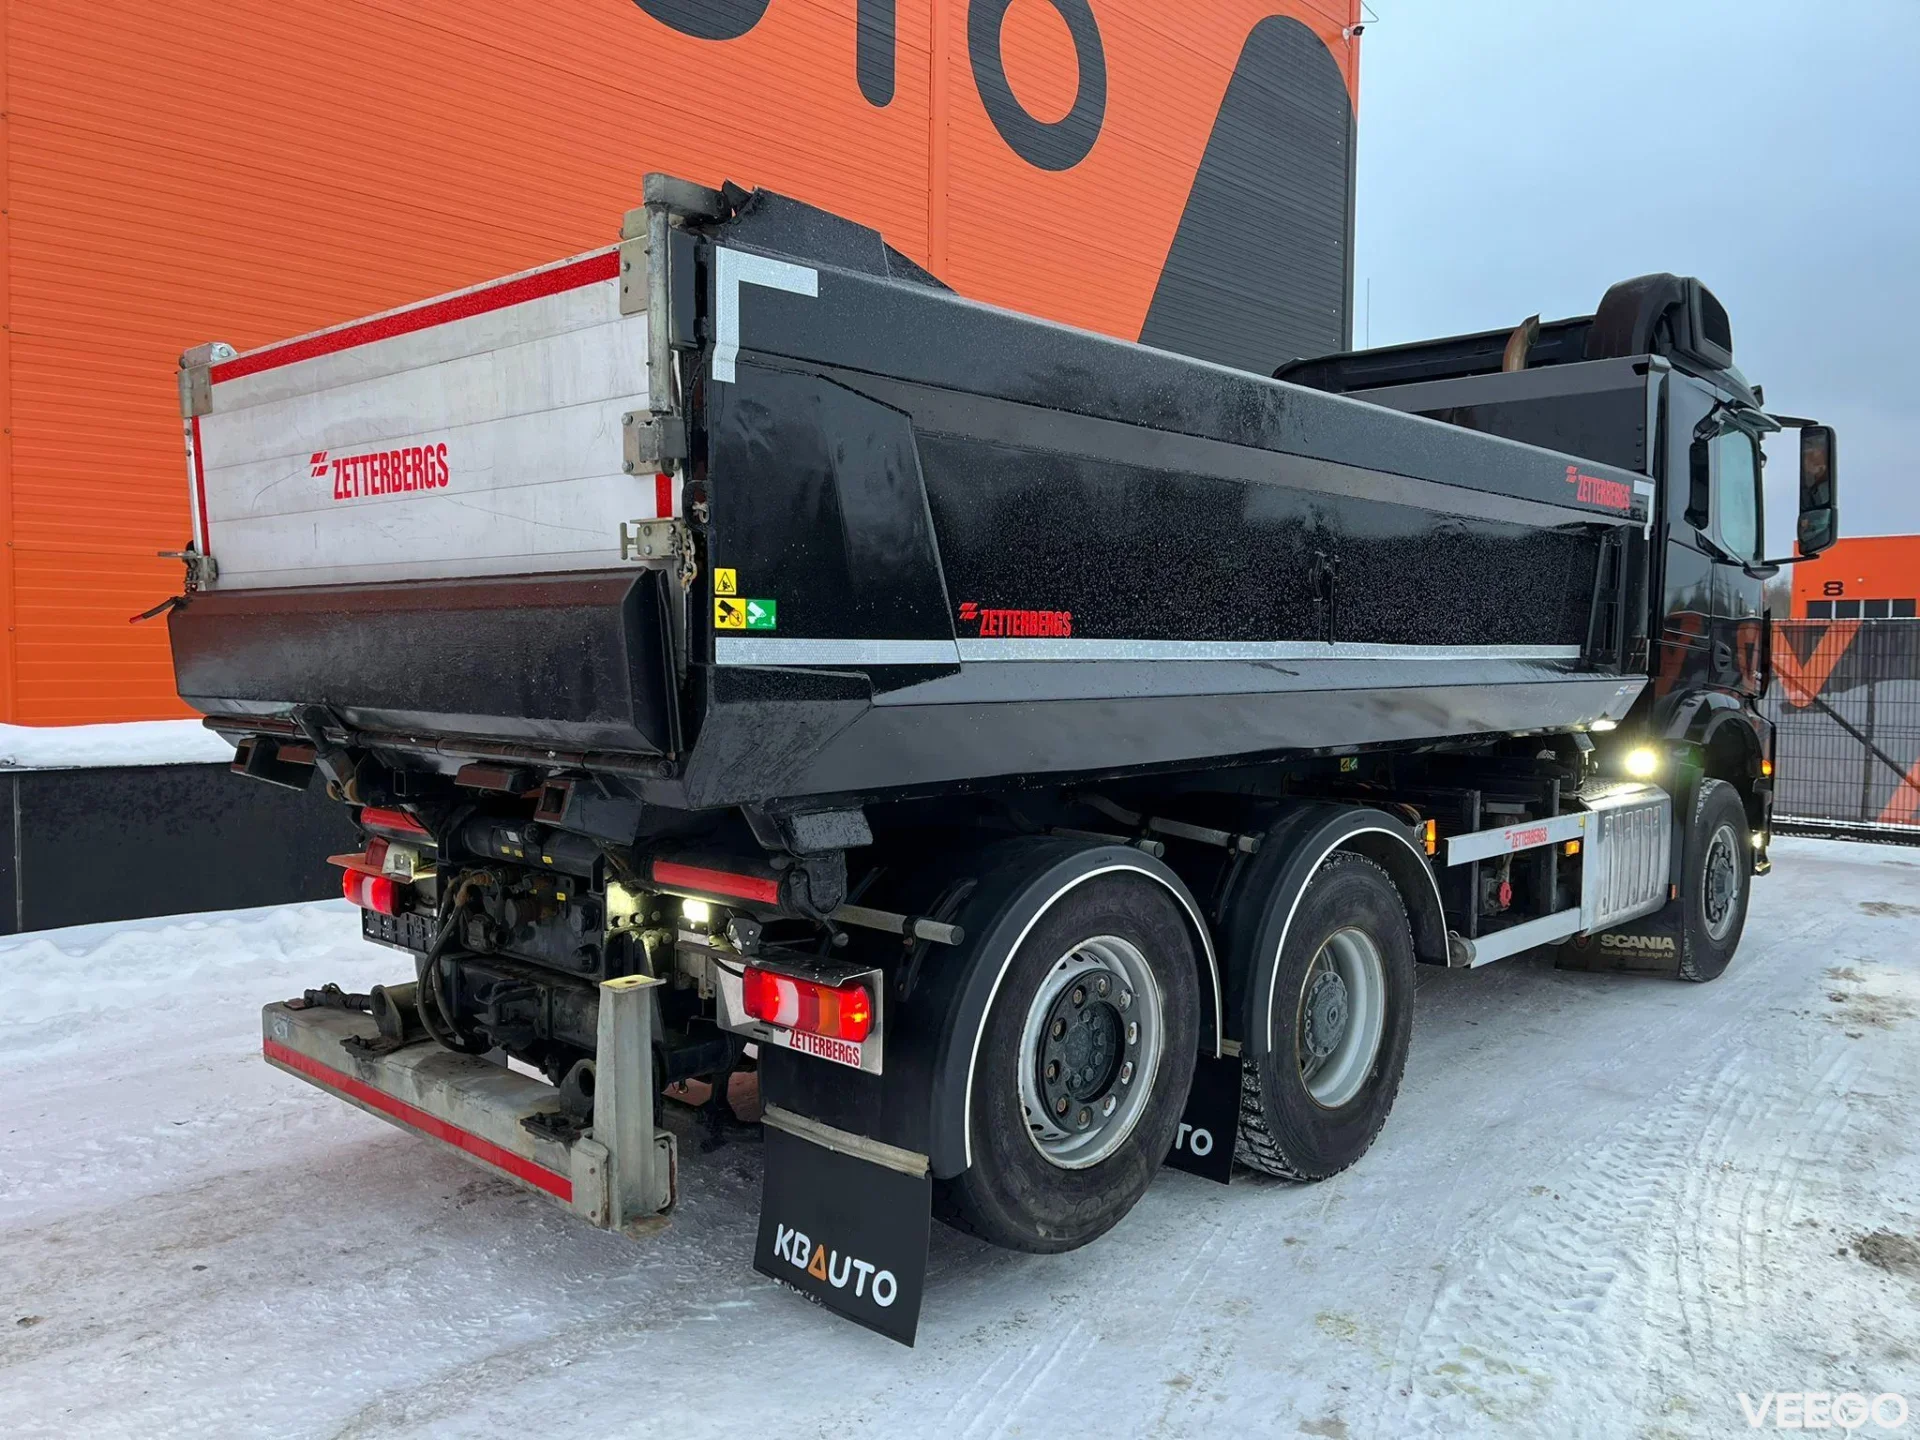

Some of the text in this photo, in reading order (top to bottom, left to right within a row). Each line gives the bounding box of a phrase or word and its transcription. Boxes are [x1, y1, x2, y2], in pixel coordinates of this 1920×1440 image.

[332, 442, 449, 500] ZETTERBERGS
[1577, 474, 1630, 510] ZETTERBERGS
[1823, 580, 1844, 597] 8
[980, 609, 1072, 637] ZETTERBERGS
[1601, 934, 1676, 950] SCANIA
[789, 1029, 860, 1067] ZETTERBERGS
